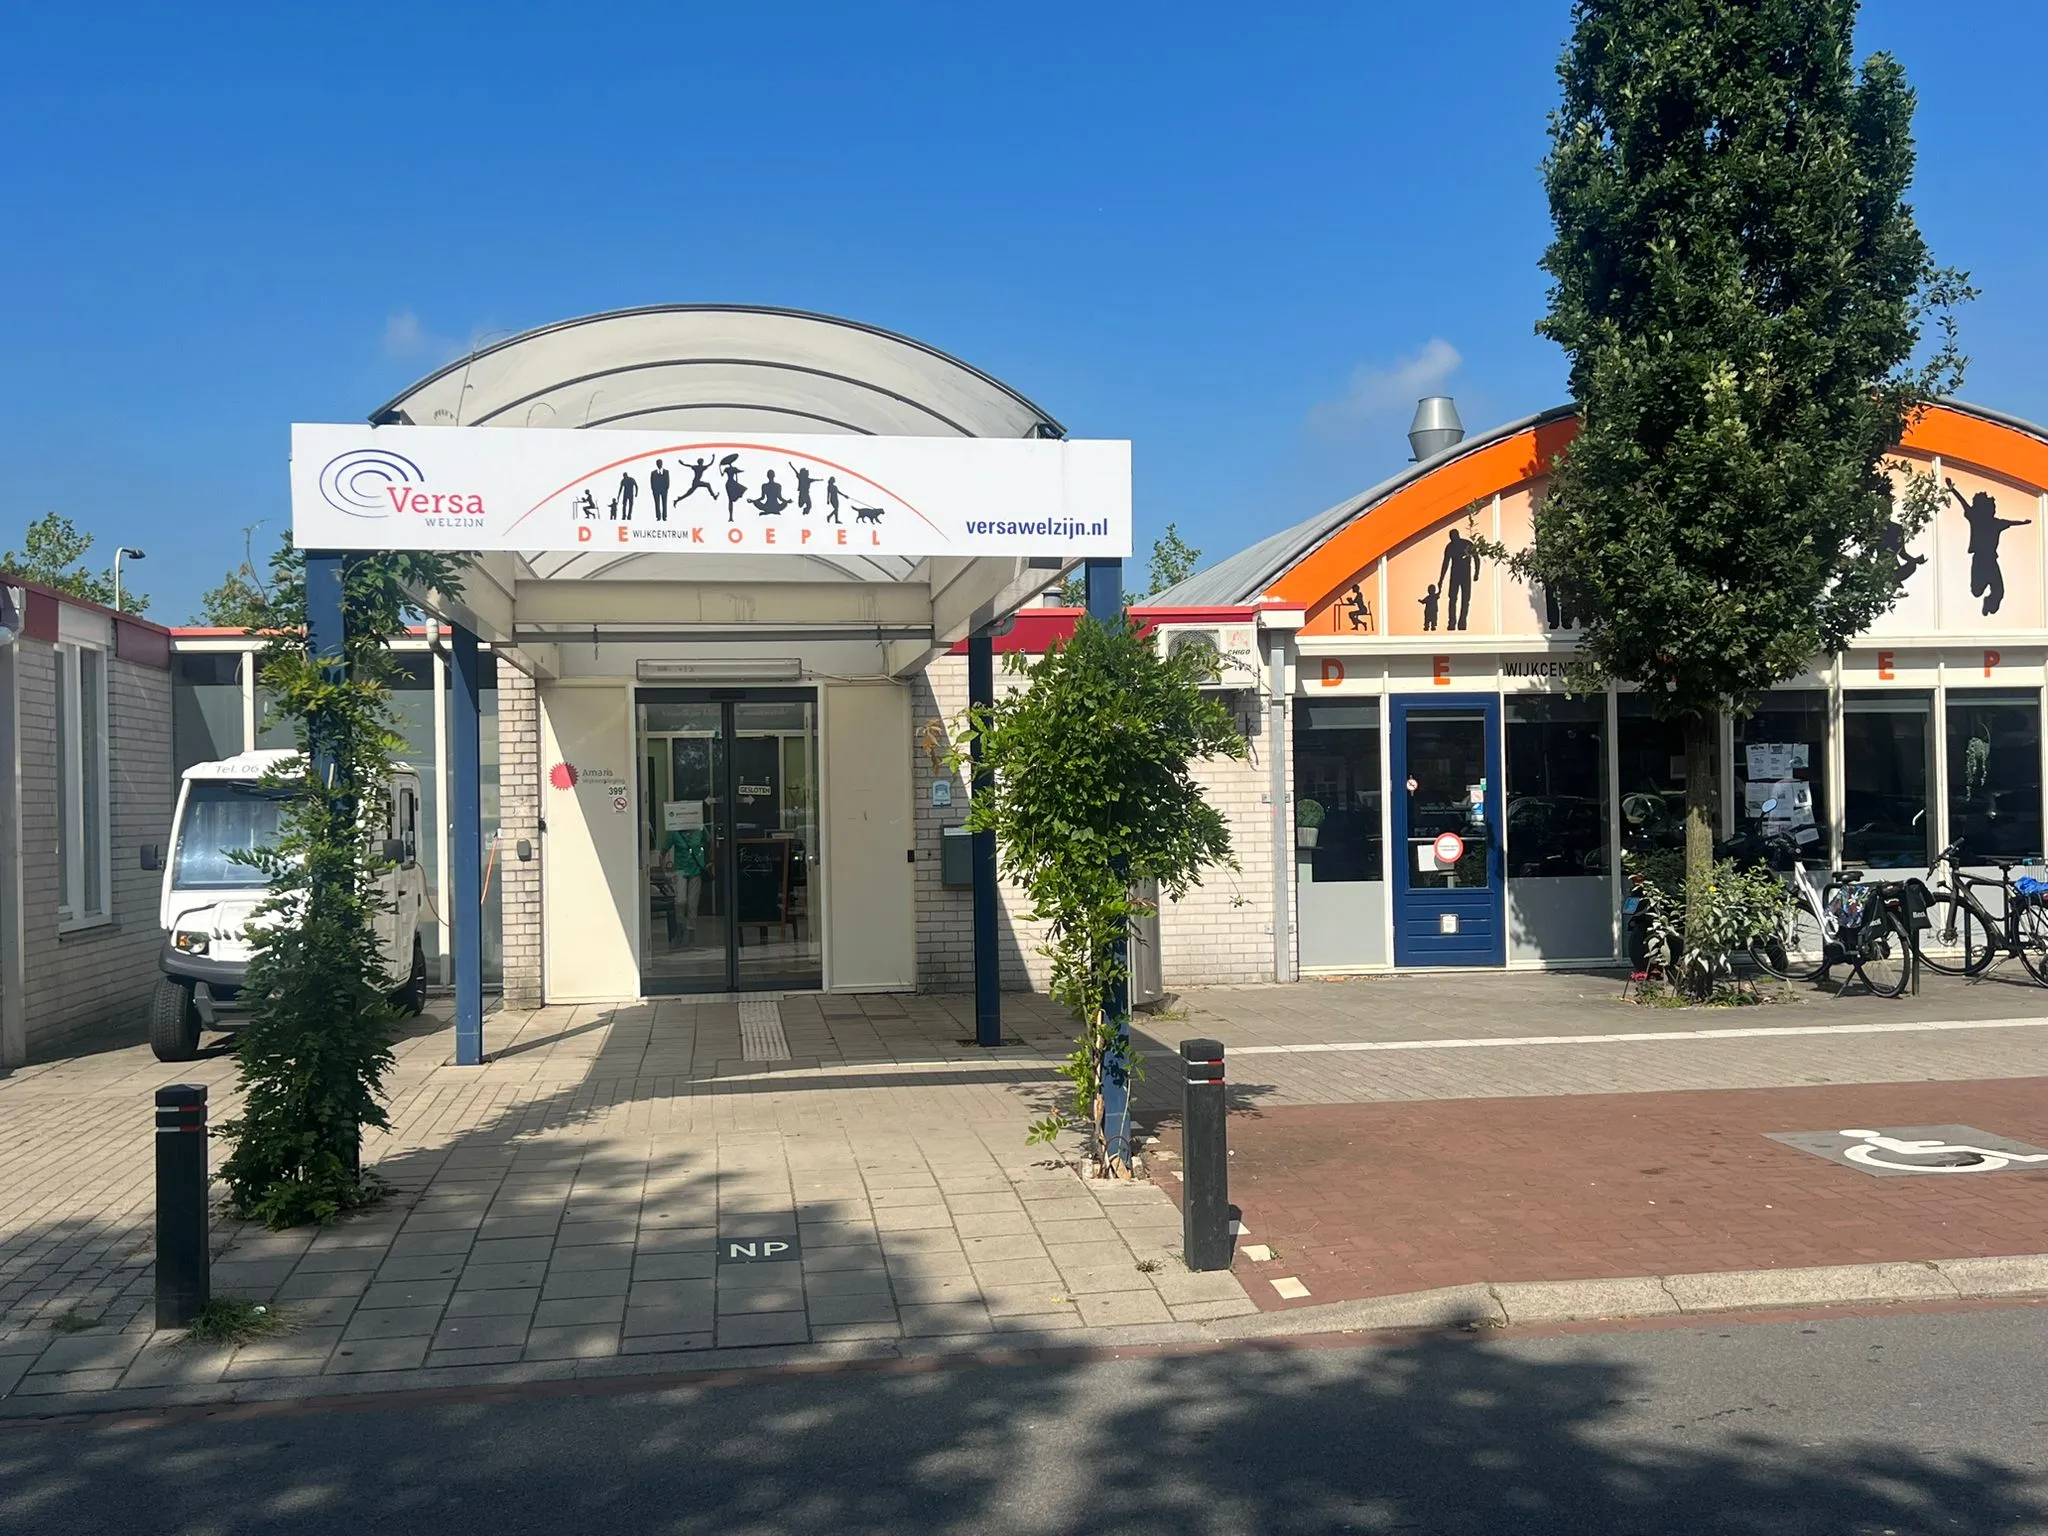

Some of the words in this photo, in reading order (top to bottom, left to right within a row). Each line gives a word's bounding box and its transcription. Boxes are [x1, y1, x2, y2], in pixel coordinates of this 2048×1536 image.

[386, 487, 485, 514] Versa
[425, 518, 484, 527] WELZIJN
[966, 517, 1108, 539] versawelzijn.nl
[632, 529, 689, 539] WIJKCENTRUM
[1505, 662, 1610, 677] WIJKCENU
[582, 767, 614, 777] Amaris
[739, 786, 770, 794] GESLOTEN
[730, 1242, 789, 1258] NP
